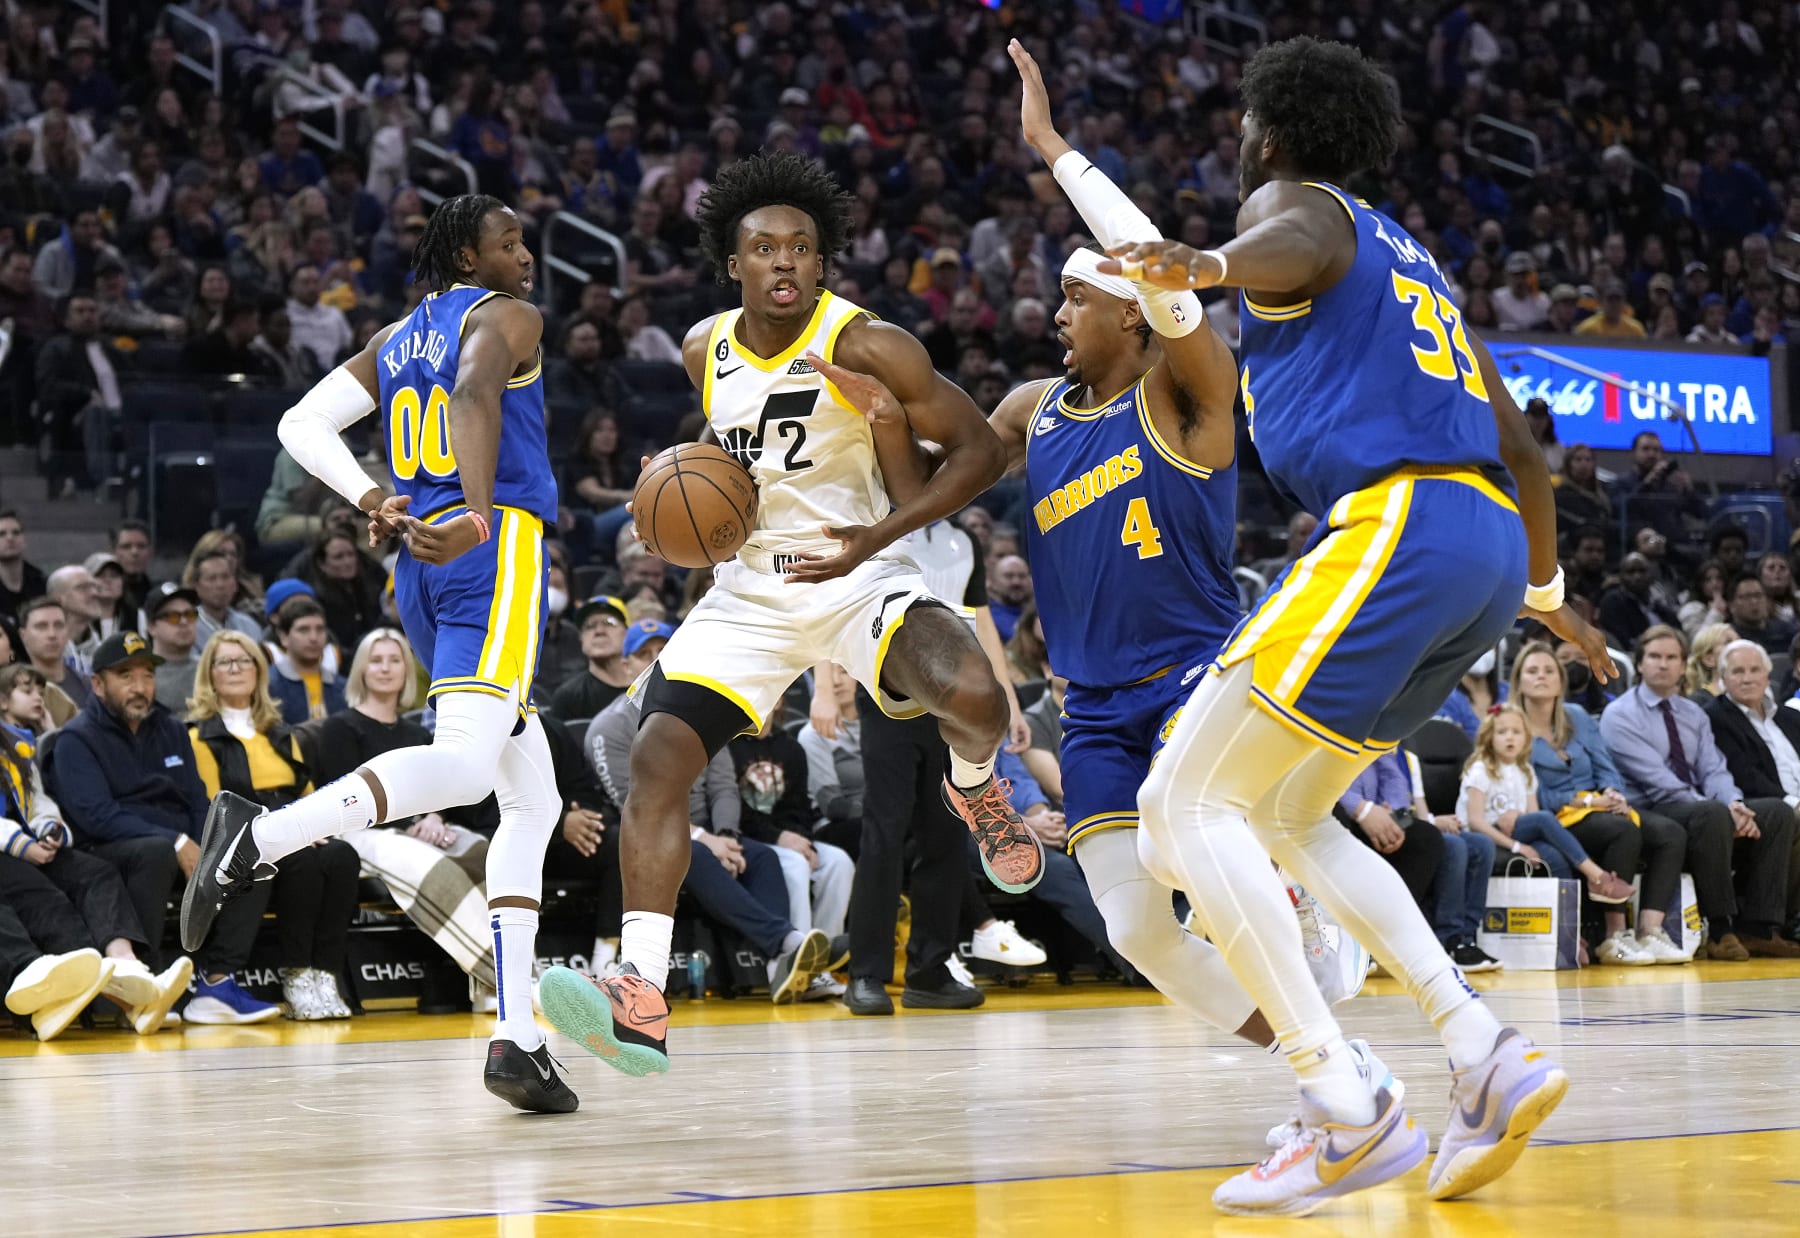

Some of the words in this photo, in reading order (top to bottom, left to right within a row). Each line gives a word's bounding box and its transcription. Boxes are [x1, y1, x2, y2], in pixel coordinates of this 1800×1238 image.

[719, 342, 728, 359] 6
[1391, 268, 1490, 403] 33
[390, 384, 458, 480] 00
[778, 420, 814, 472] 2
[1039, 416, 1056, 429] NIKE
[1033, 443, 1144, 536] WARRIORS
[1121, 497, 1163, 560] 4
[773, 553, 802, 574] UTA
[360, 961, 422, 982] CHAS
